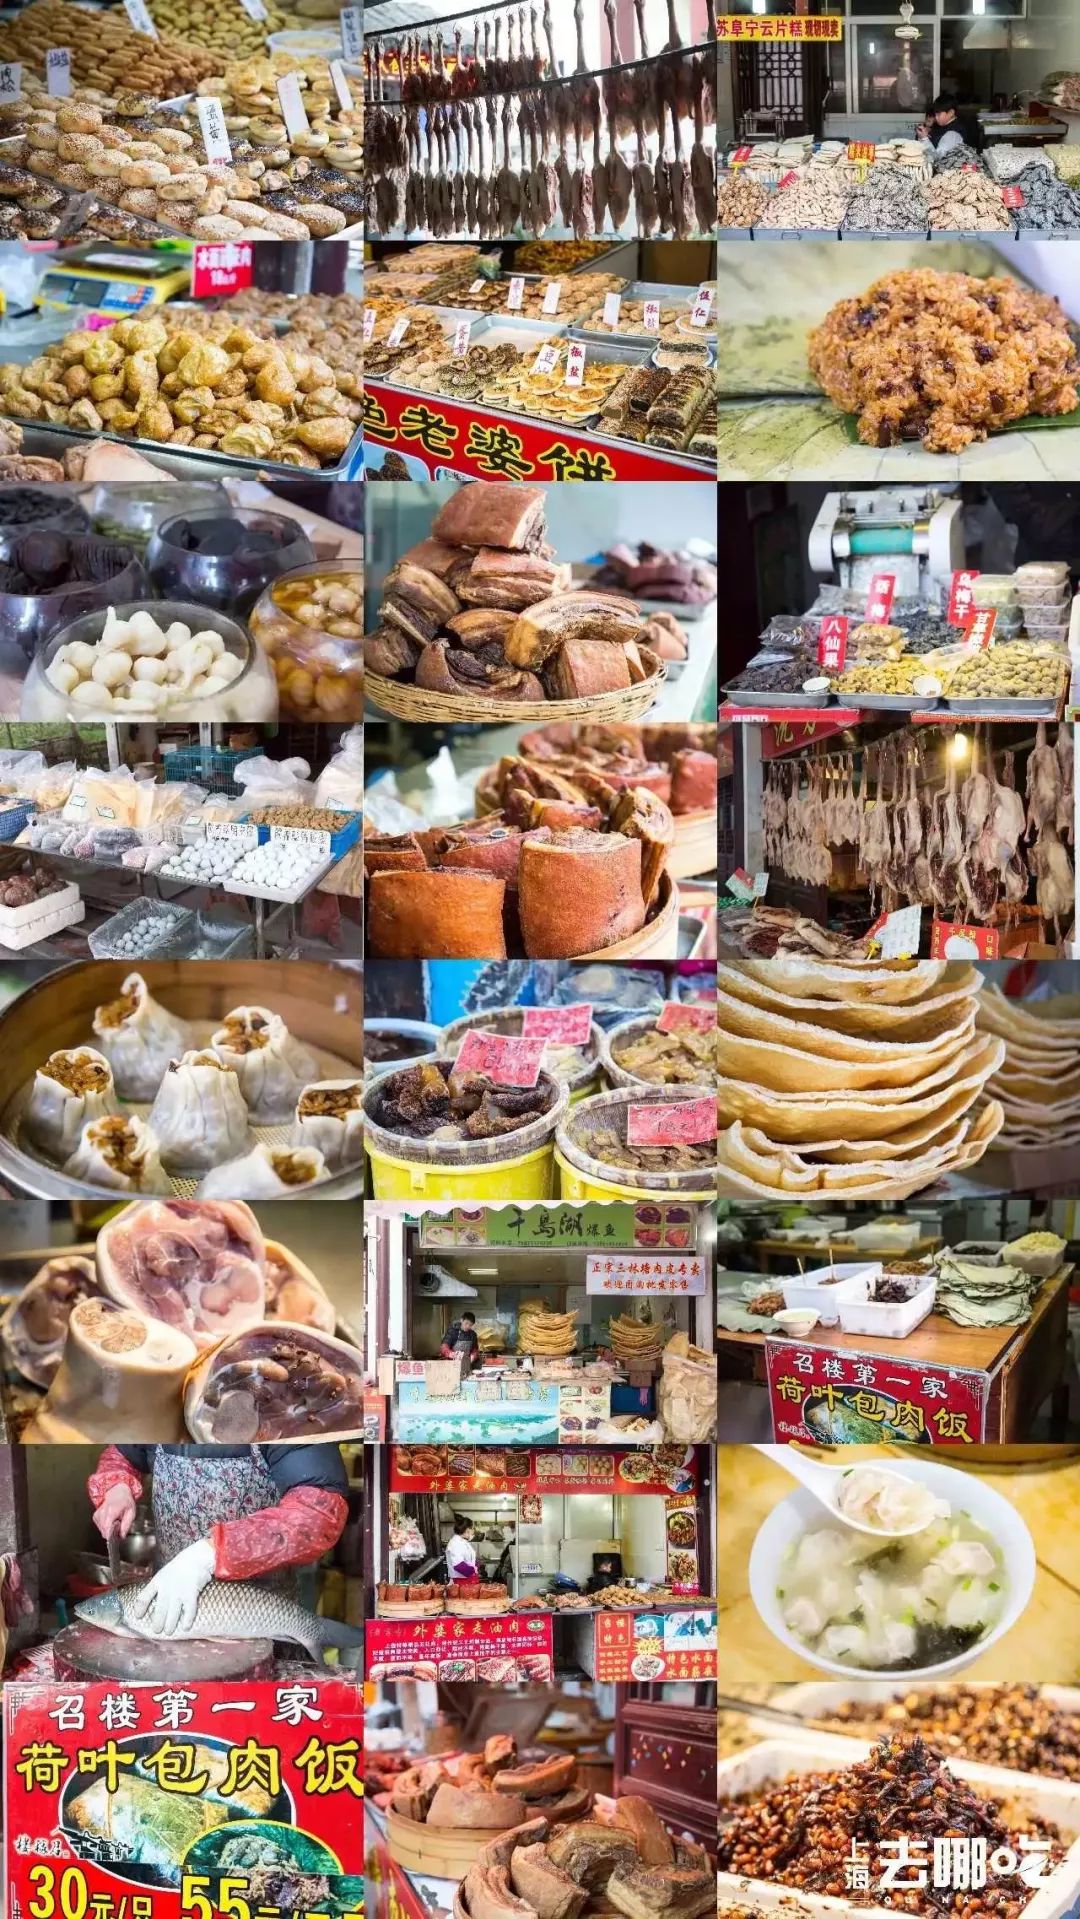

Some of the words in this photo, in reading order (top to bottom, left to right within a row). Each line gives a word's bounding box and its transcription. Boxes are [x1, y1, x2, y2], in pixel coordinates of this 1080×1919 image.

[717, 19, 802, 37] 苏阜宁云片糕
[823, 620, 842, 668] 八仙果
[793, 1352, 949, 1400] 召楼第一家
[775, 1375, 975, 1444] 荷叶包肉饭
[413, 1621, 521, 1639] 外婆家走油肉
[48, 1685, 325, 1732] 召楼第一家
[15, 1735, 364, 1799] 荷叶包肉饭
